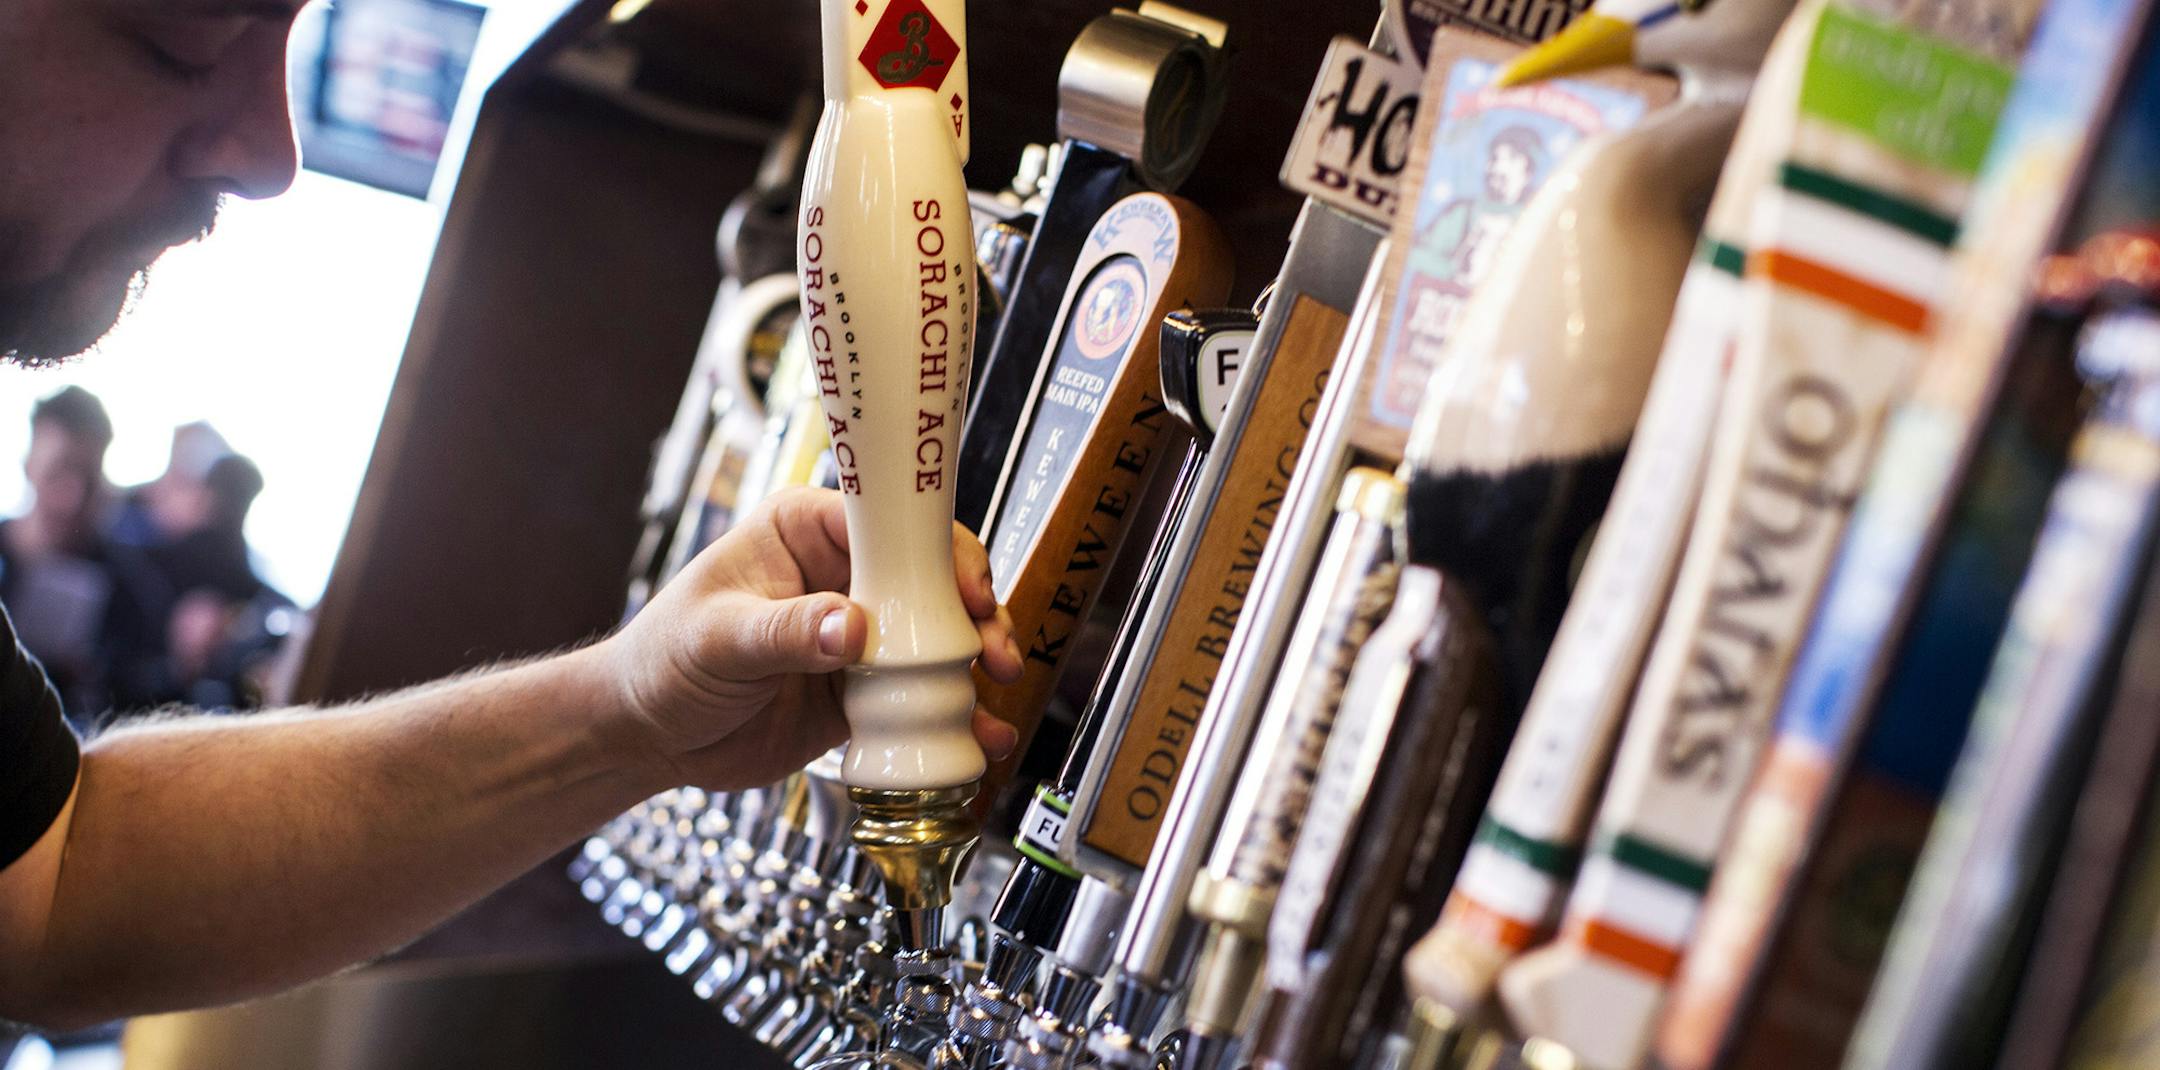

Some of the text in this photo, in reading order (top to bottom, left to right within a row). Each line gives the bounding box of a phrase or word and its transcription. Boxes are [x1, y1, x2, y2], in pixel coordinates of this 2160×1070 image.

[1311, 163, 1398, 215] DU
[805, 206, 862, 495] SORACHI ACE
[829, 272, 862, 419] BROOKLYN
[913, 200, 948, 493] SORACHI ACE
[953, 263, 970, 411] BROOKLYN
[1044, 384, 1100, 414] MAIN IPA
[1056, 365, 1105, 394] REEFED
[1127, 678, 1214, 822] ODELL
[1195, 445, 1300, 664] BREWING
